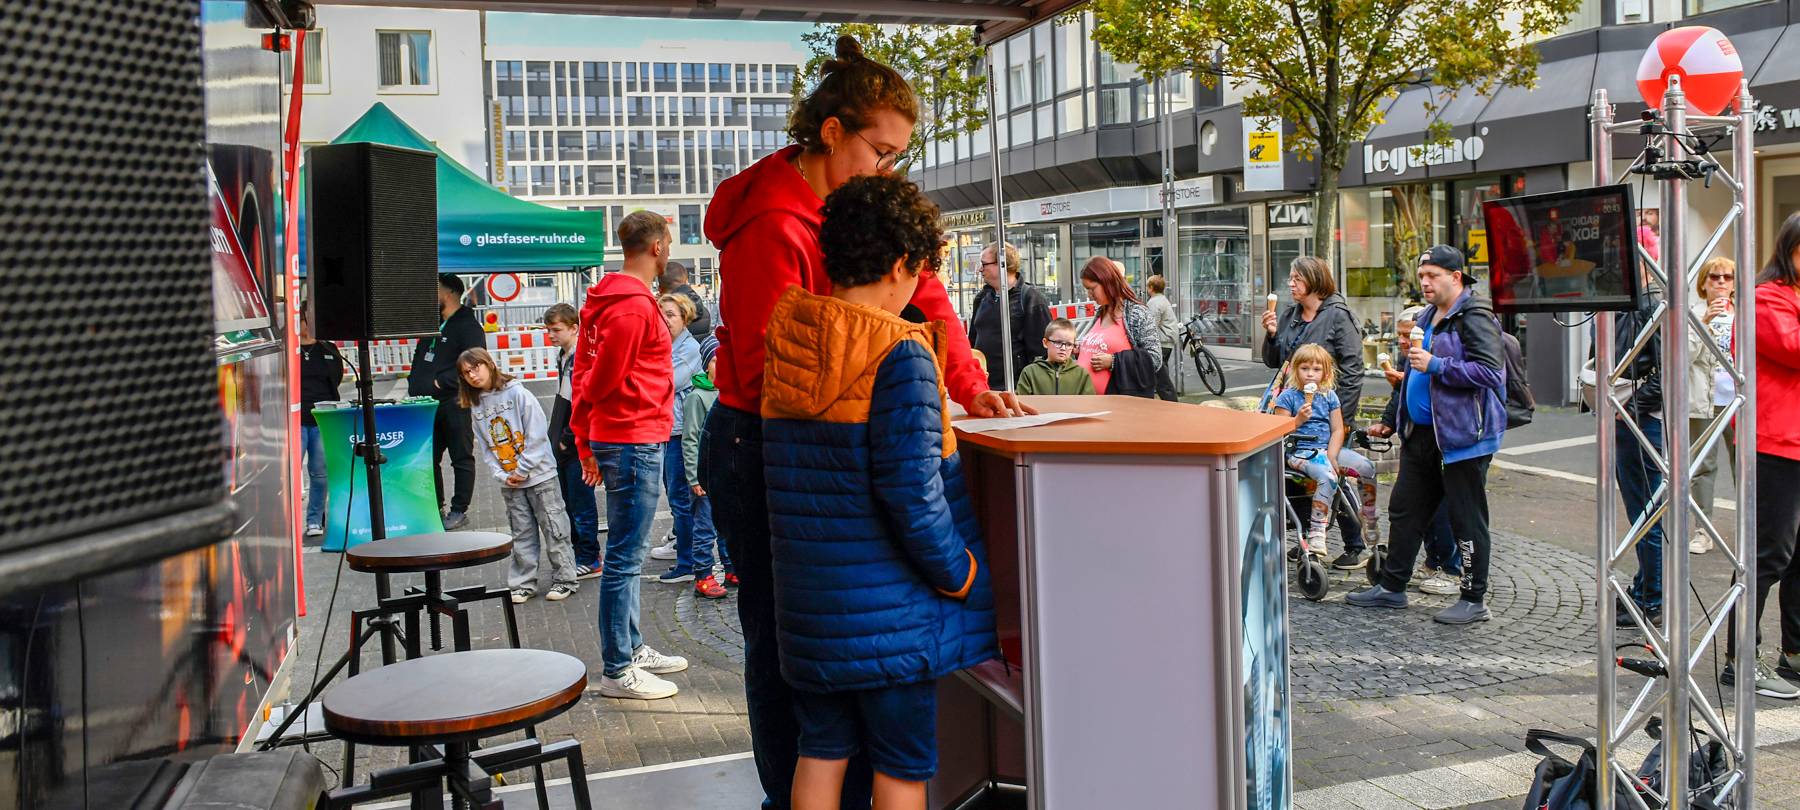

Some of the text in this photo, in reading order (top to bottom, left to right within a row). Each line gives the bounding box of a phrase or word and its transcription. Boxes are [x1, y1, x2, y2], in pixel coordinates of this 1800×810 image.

[1364, 136, 1484, 175] leguano
[476, 232, 586, 247] glasfaser-ruhr.de
[349, 431, 404, 443] GLFASER
